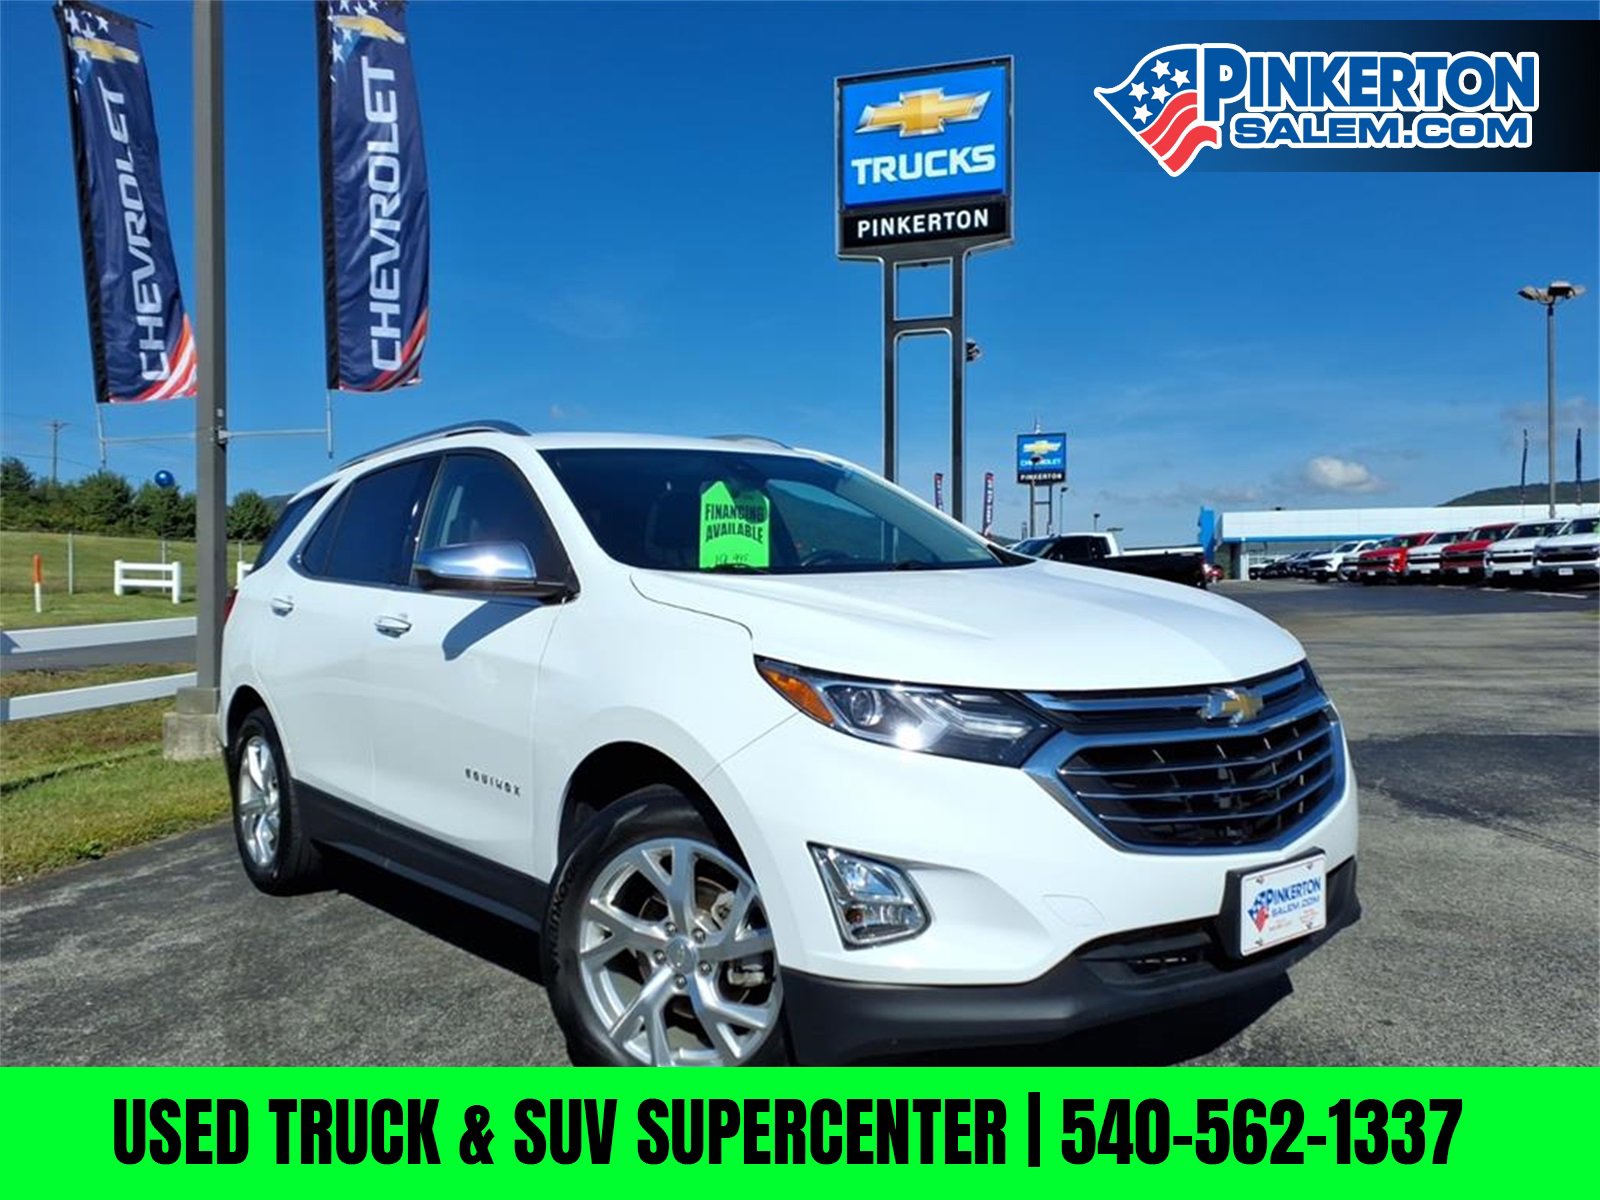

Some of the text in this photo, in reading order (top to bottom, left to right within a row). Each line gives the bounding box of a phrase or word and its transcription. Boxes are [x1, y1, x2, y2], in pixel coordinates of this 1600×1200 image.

[851, 144, 996, 185] TRUCKS
[361, 56, 402, 370] CHEVROLET
[857, 209, 989, 238] PINKERTON
[98, 77, 168, 381] CHEVROLET
[705, 503, 765, 522] FINANCING
[705, 522, 763, 544] AVAILABLE
[465, 768, 520, 797] EQUINOX
[1267, 877, 1321, 905] PINKERTON
